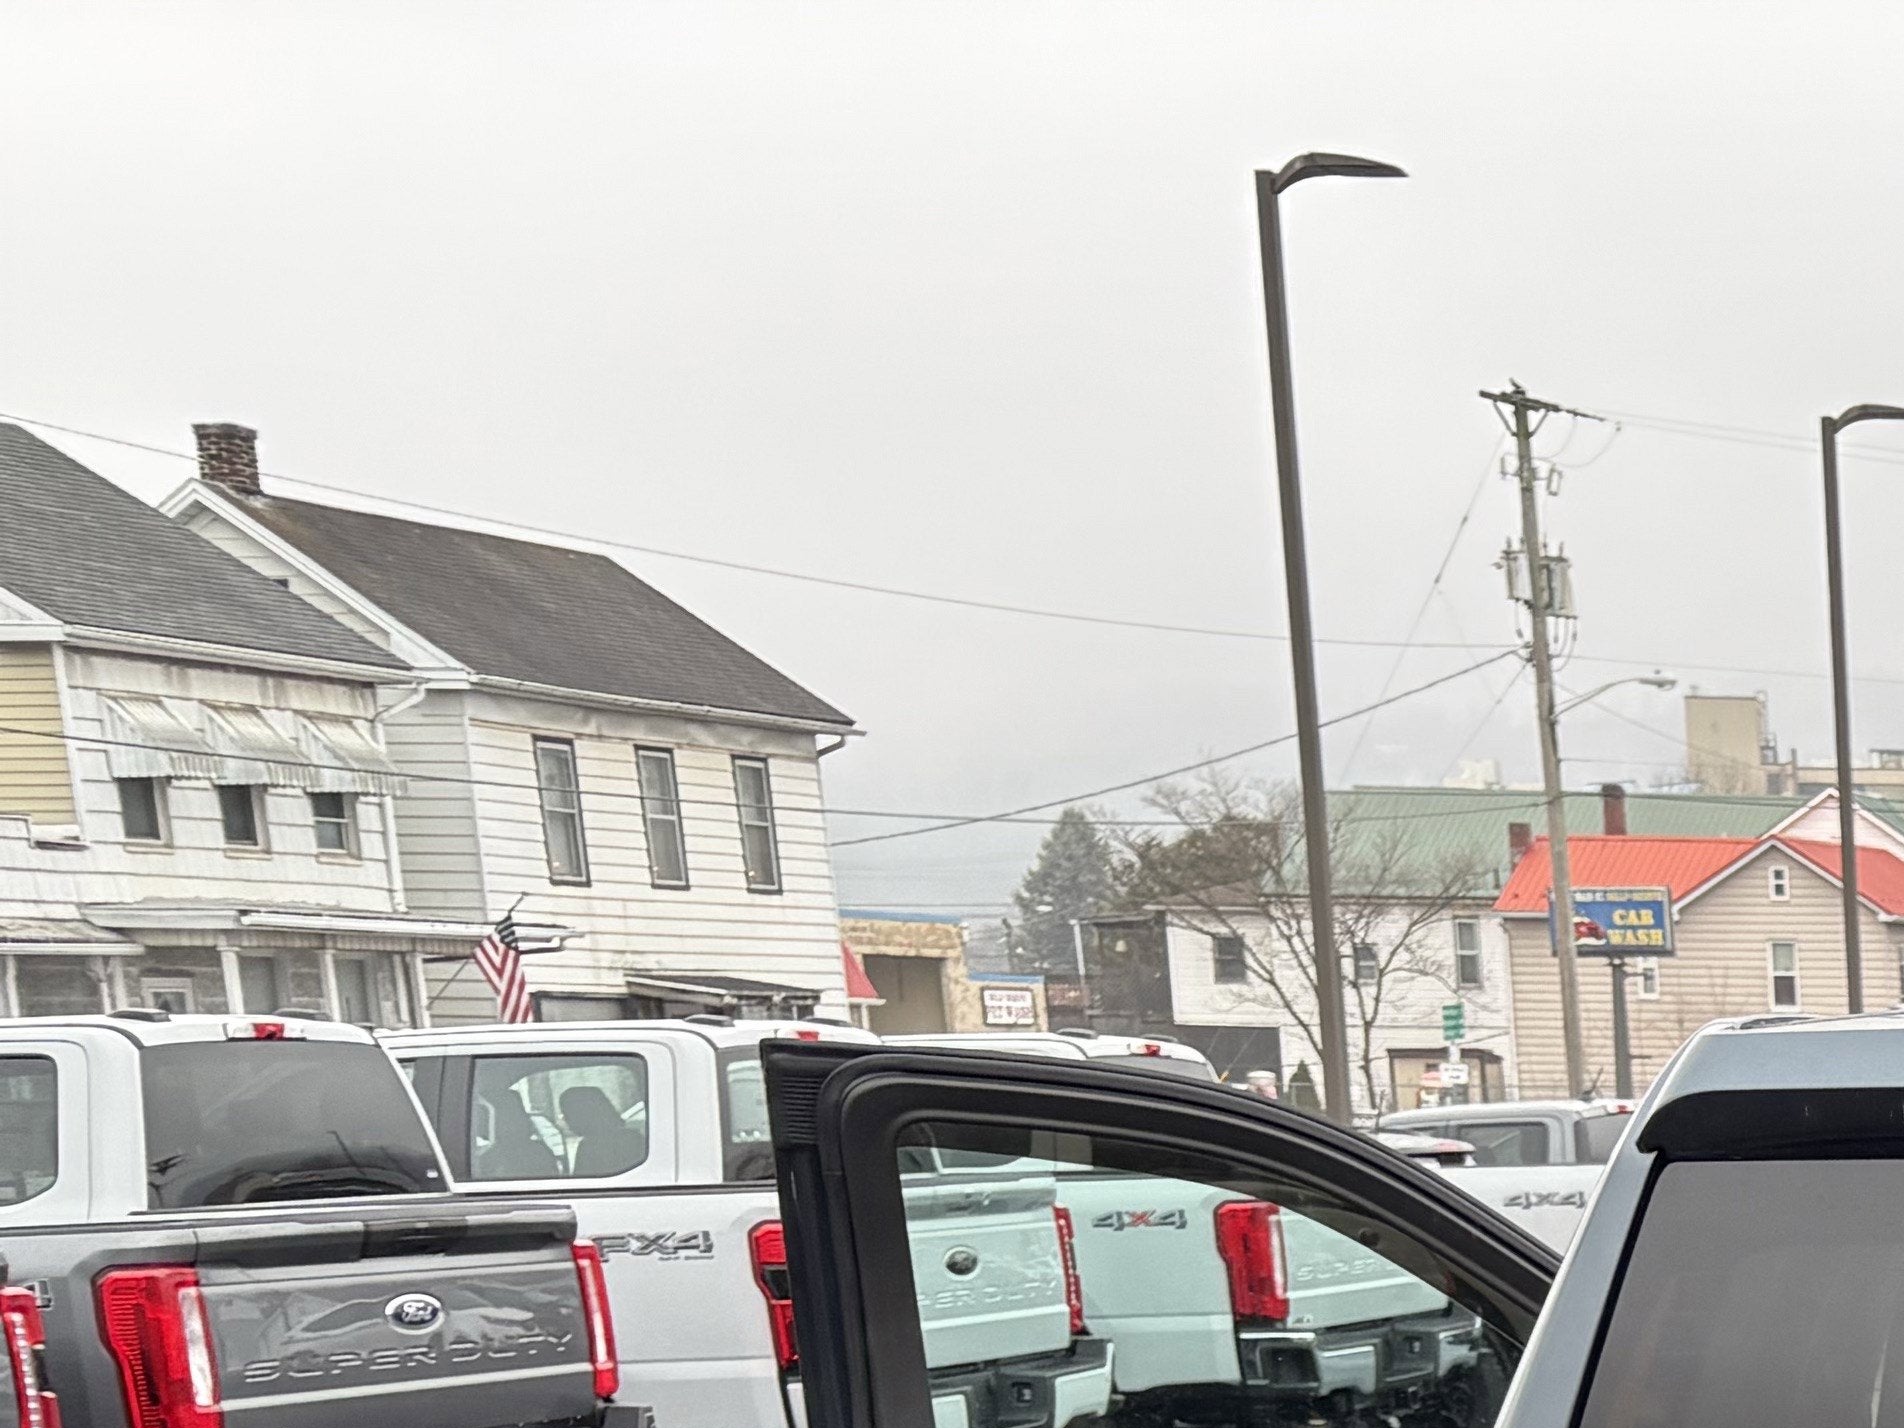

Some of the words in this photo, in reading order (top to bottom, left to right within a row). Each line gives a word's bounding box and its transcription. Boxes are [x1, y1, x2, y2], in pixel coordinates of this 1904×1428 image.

[1612, 909, 1655, 926] CAR
[1606, 928, 1665, 946] WASH
[592, 1230, 714, 1263] FX4
[244, 1347, 436, 1382] SUPER
[449, 1332, 573, 1361] DUTY
